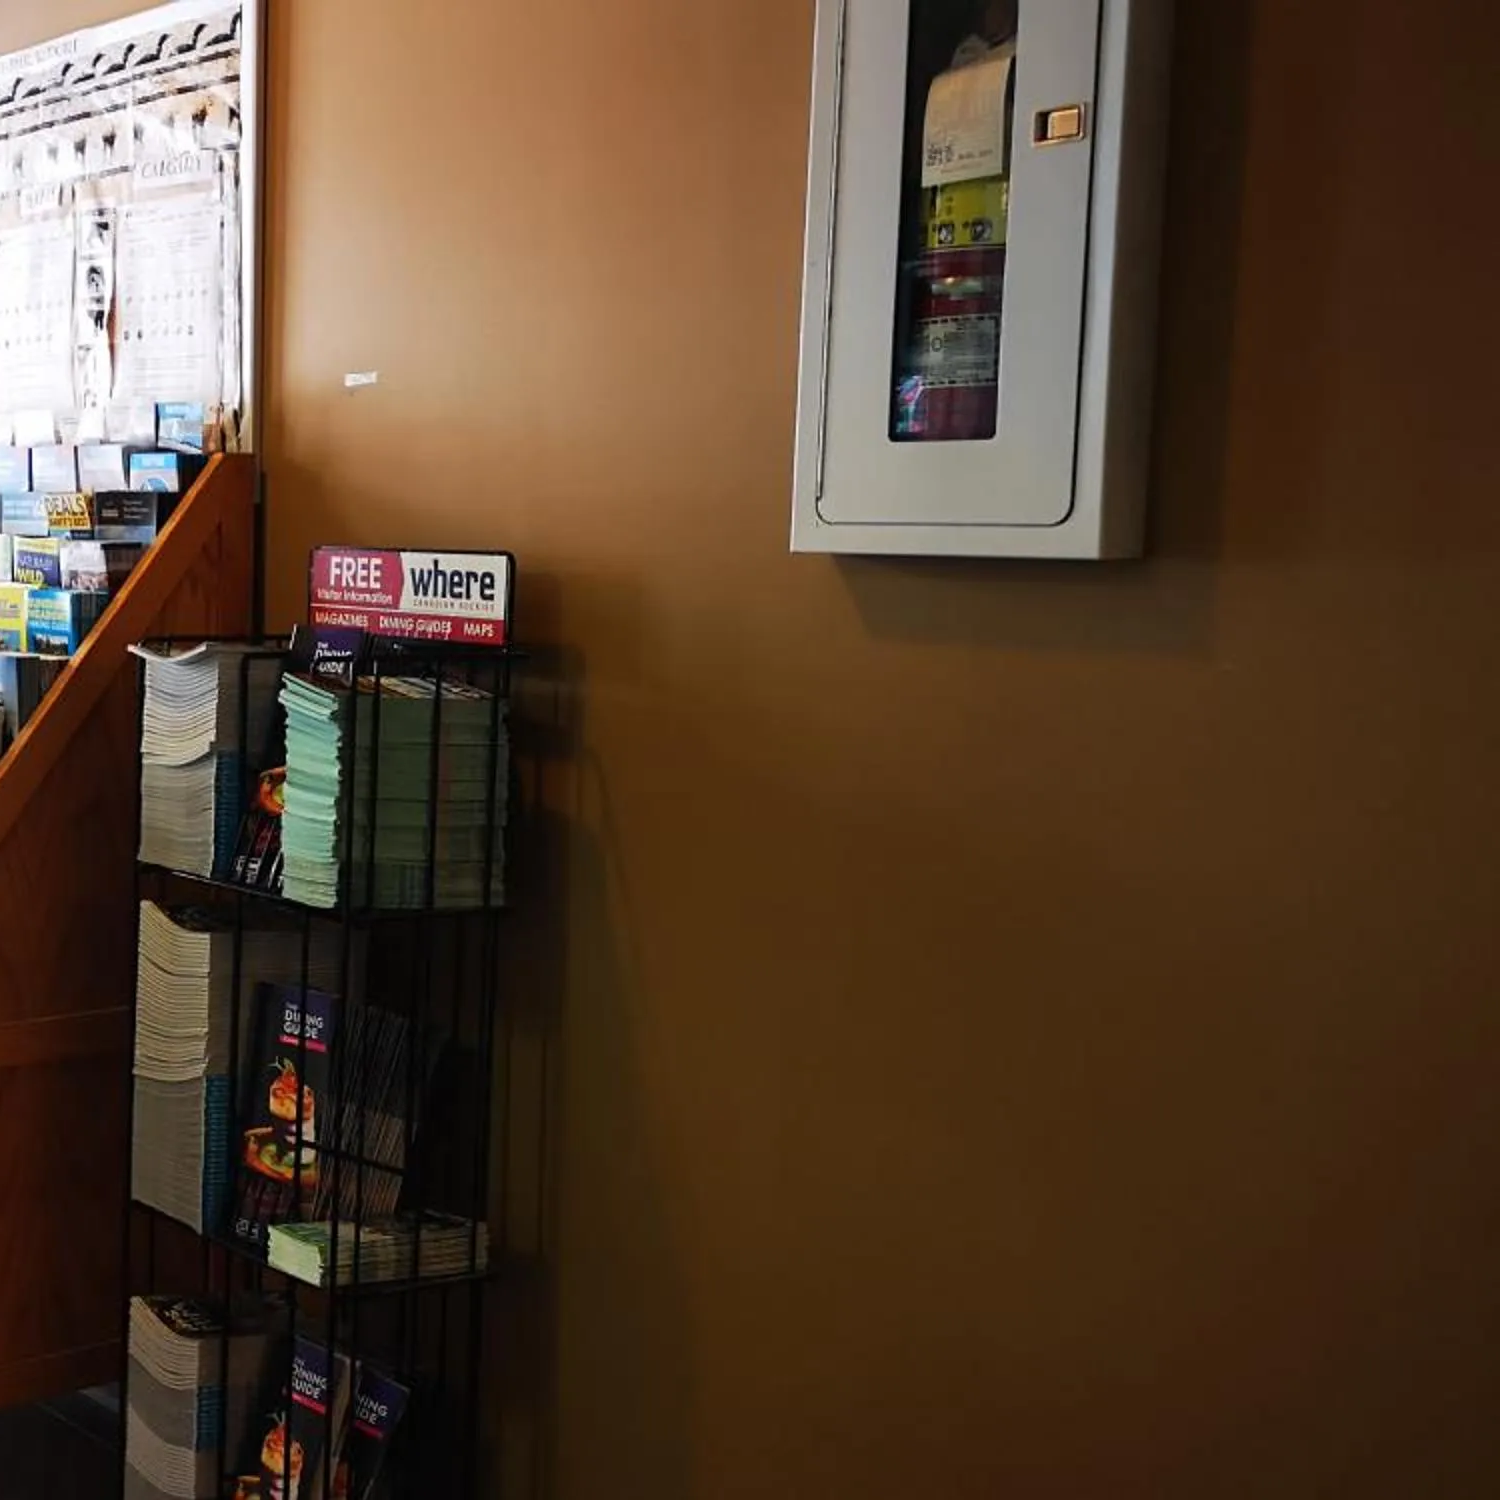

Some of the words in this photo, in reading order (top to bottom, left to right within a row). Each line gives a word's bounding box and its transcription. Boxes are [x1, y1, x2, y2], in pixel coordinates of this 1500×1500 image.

[329, 556, 383, 588] FREE
[411, 559, 495, 601] where
[317, 588, 342, 601] Visitor
[343, 588, 393, 604] Information
[413, 600, 456, 609] CANADIAN
[459, 602, 495, 612] ROCKIES
[315, 612, 369, 627] MAGAZINES
[379, 616, 414, 631] DINING
[415, 619, 452, 634] GUIDES
[463, 622, 494, 637] MAPS
[284, 1021, 319, 1039] GUDE
